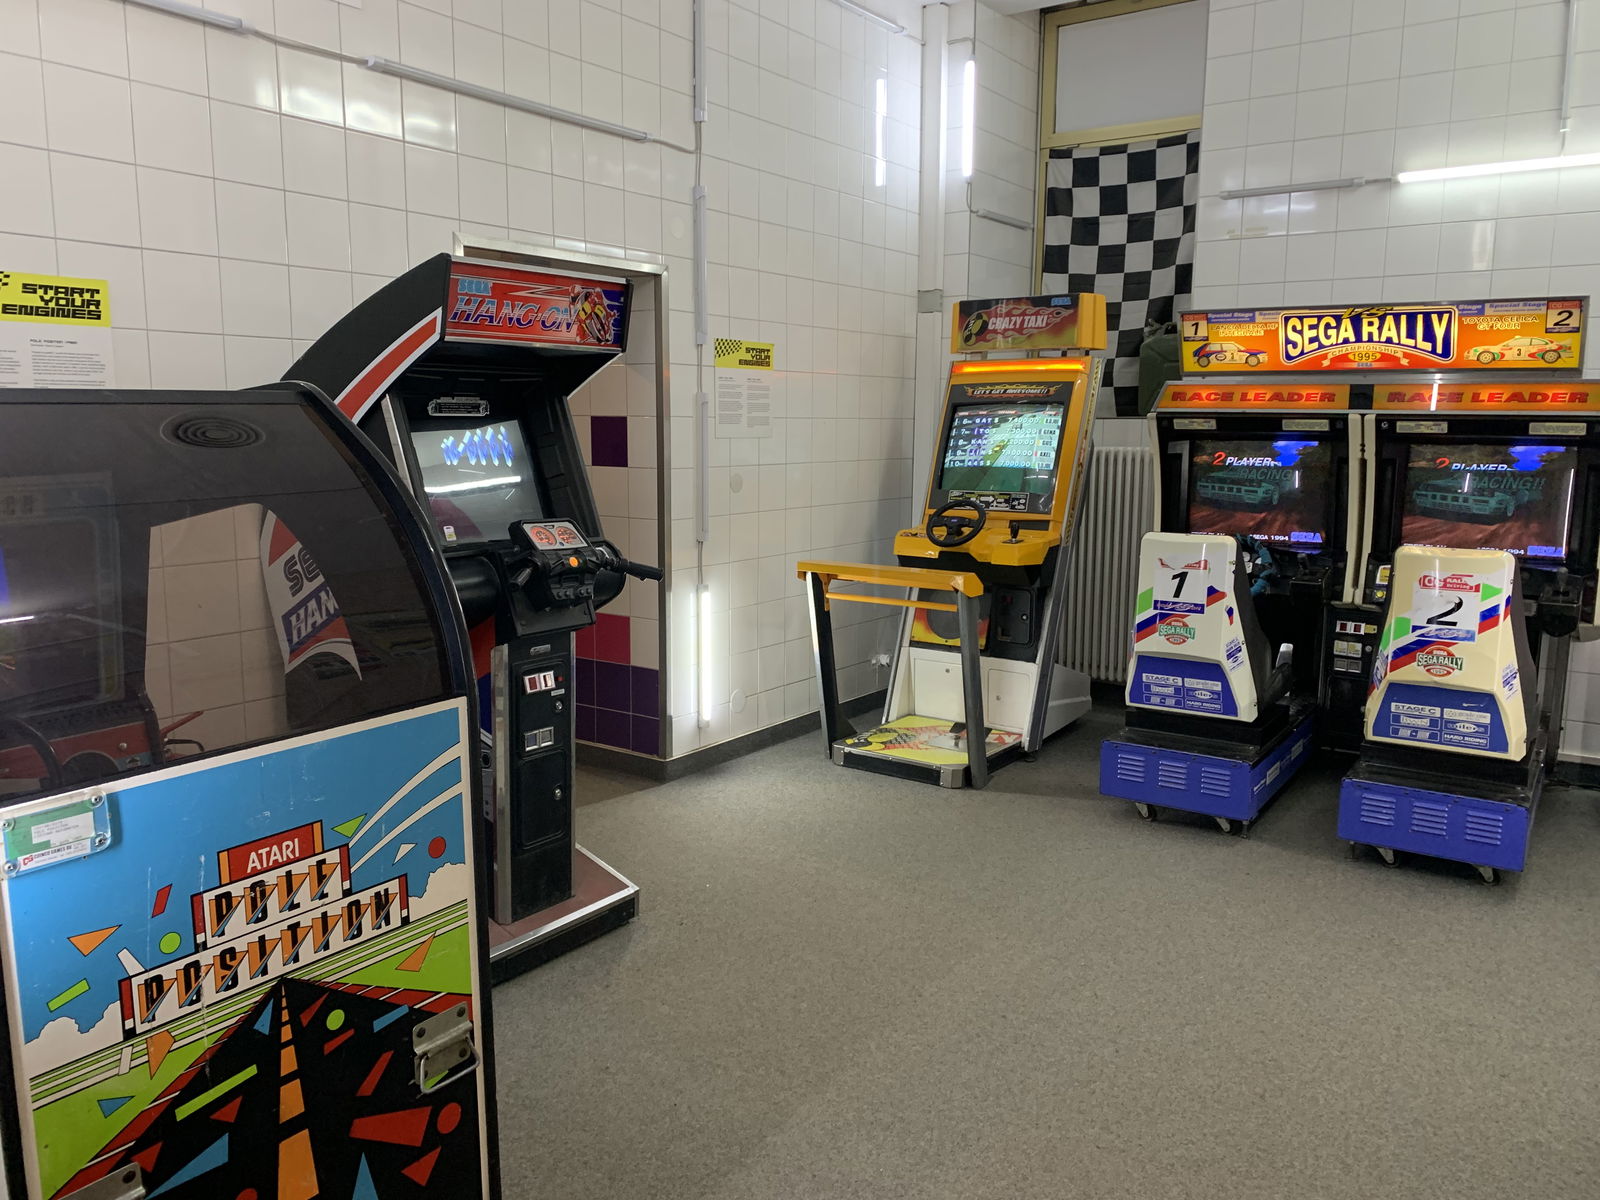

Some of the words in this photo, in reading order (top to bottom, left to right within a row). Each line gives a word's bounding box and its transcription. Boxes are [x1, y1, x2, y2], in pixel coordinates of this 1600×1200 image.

[22, 283, 100, 298] START
[458, 277, 492, 295] SEGA
[39, 295, 101, 309] YOUR
[2, 304, 101, 320] ENGINES
[448, 296, 578, 332] HANG-ON
[1502, 315, 1539, 323] CELICA
[1553, 310, 1573, 327] 2
[988, 316, 1023, 330] CRAZY
[1023, 315, 1048, 328] TAXI
[1191, 322, 1199, 336] 1
[1287, 316, 1356, 356] SEGA
[1362, 313, 1449, 354] RALLY
[751, 353, 770, 361] YOUR
[1331, 345, 1399, 356] CHAMPIONSHIP
[1352, 352, 1377, 361] 1995
[1516, 348, 1522, 357] 3
[738, 359, 770, 367] ENGINES
[1171, 391, 1234, 402] RACE
[1240, 391, 1336, 402] LEADER
[1387, 391, 1464, 403] RACE
[1471, 392, 1589, 403] LEADER
[1213, 451, 1227, 466] 2
[1171, 571, 1189, 598] 1
[1426, 595, 1463, 626] 2
[1417, 652, 1441, 667] SEGA
[1441, 655, 1464, 671] RALLY
[247, 838, 299, 873] ATARI
[209, 858, 340, 937] POLE
[137, 888, 398, 1023] POSITION
